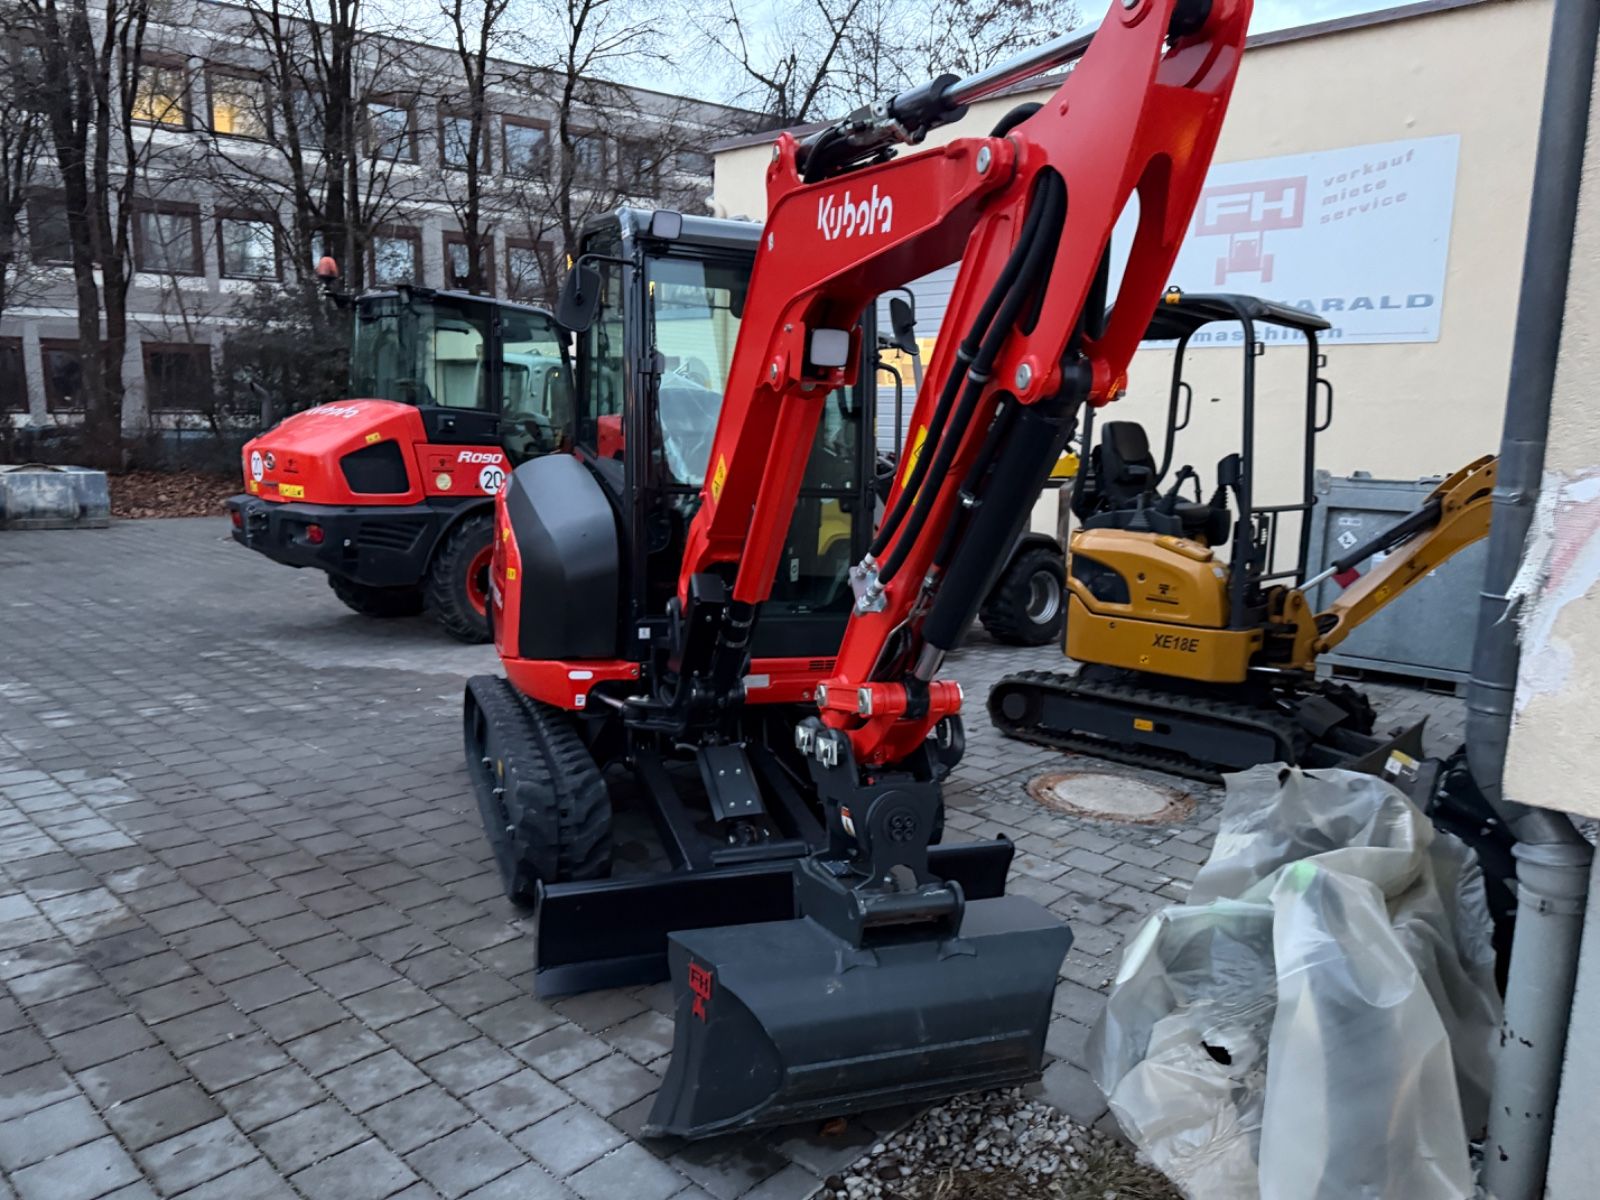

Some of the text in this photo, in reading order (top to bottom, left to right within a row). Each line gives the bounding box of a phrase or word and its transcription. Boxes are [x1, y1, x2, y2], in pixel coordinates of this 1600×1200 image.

[1321, 179, 1387, 206] miete
[817, 184, 893, 241] Kubota
[1203, 186, 1297, 227] FH
[1319, 191, 1408, 225] service
[1281, 294, 1434, 315] ARALD
[483, 470, 503, 489] 20
[1152, 633, 1200, 653] XE18E
